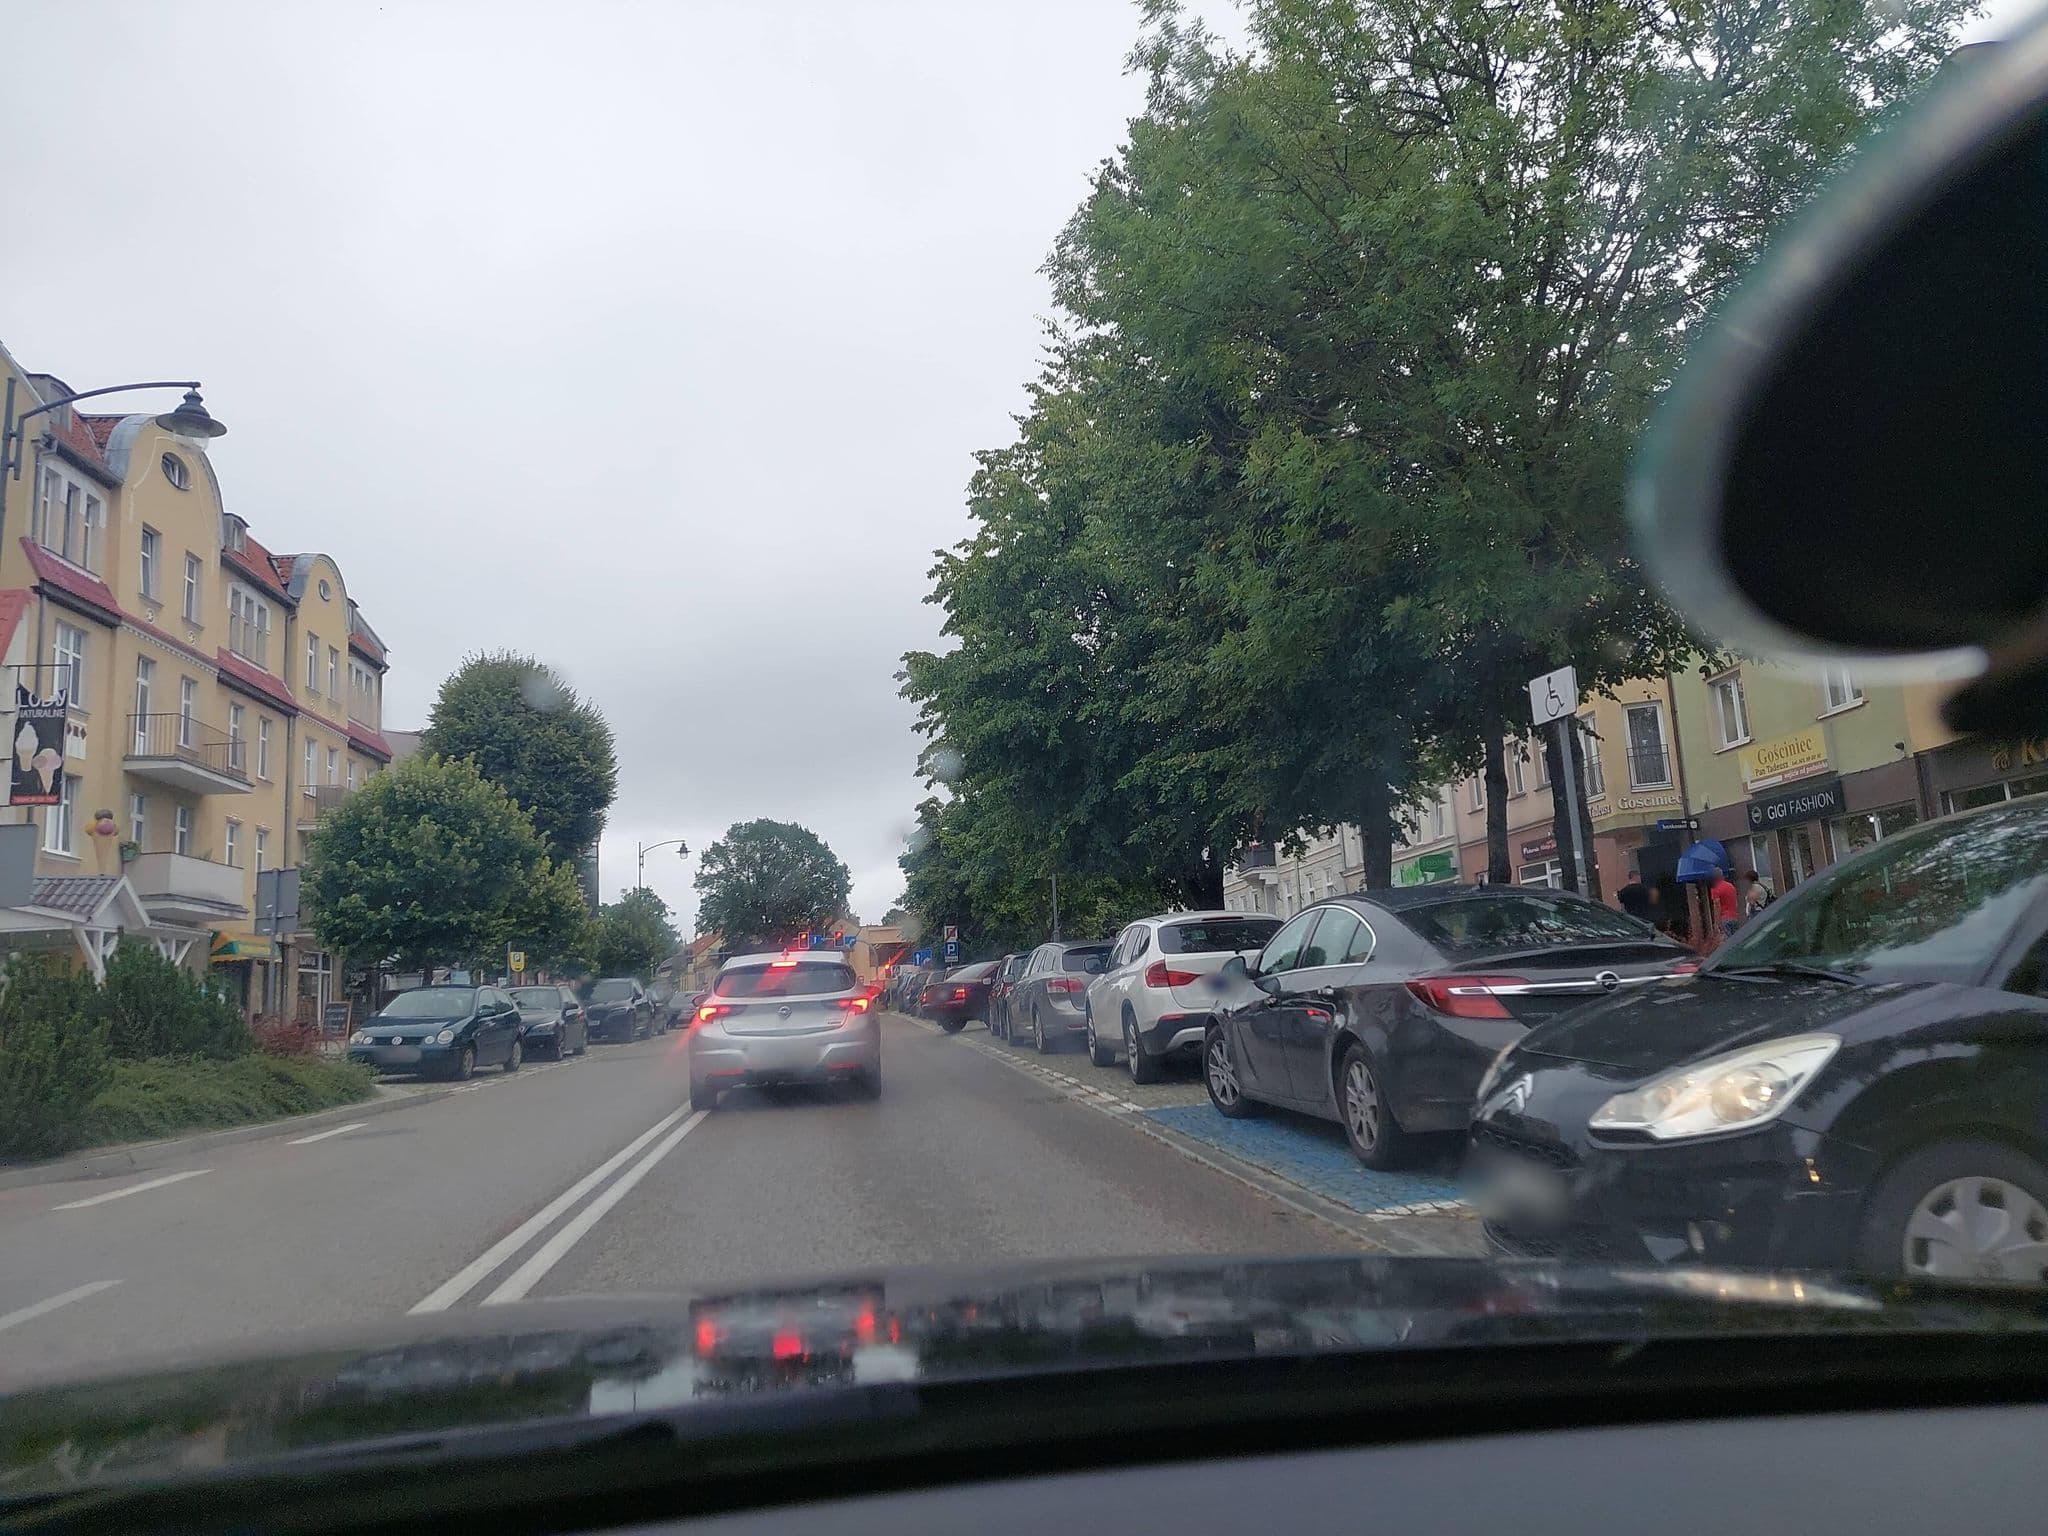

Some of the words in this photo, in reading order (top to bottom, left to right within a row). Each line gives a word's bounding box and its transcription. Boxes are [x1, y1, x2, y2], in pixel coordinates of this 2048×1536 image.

[1757, 737, 1812, 764] Gościniec
[1767, 800, 1787, 820] GIGI
[1789, 791, 1835, 815] FASHION
[947, 944, 955, 954] P
